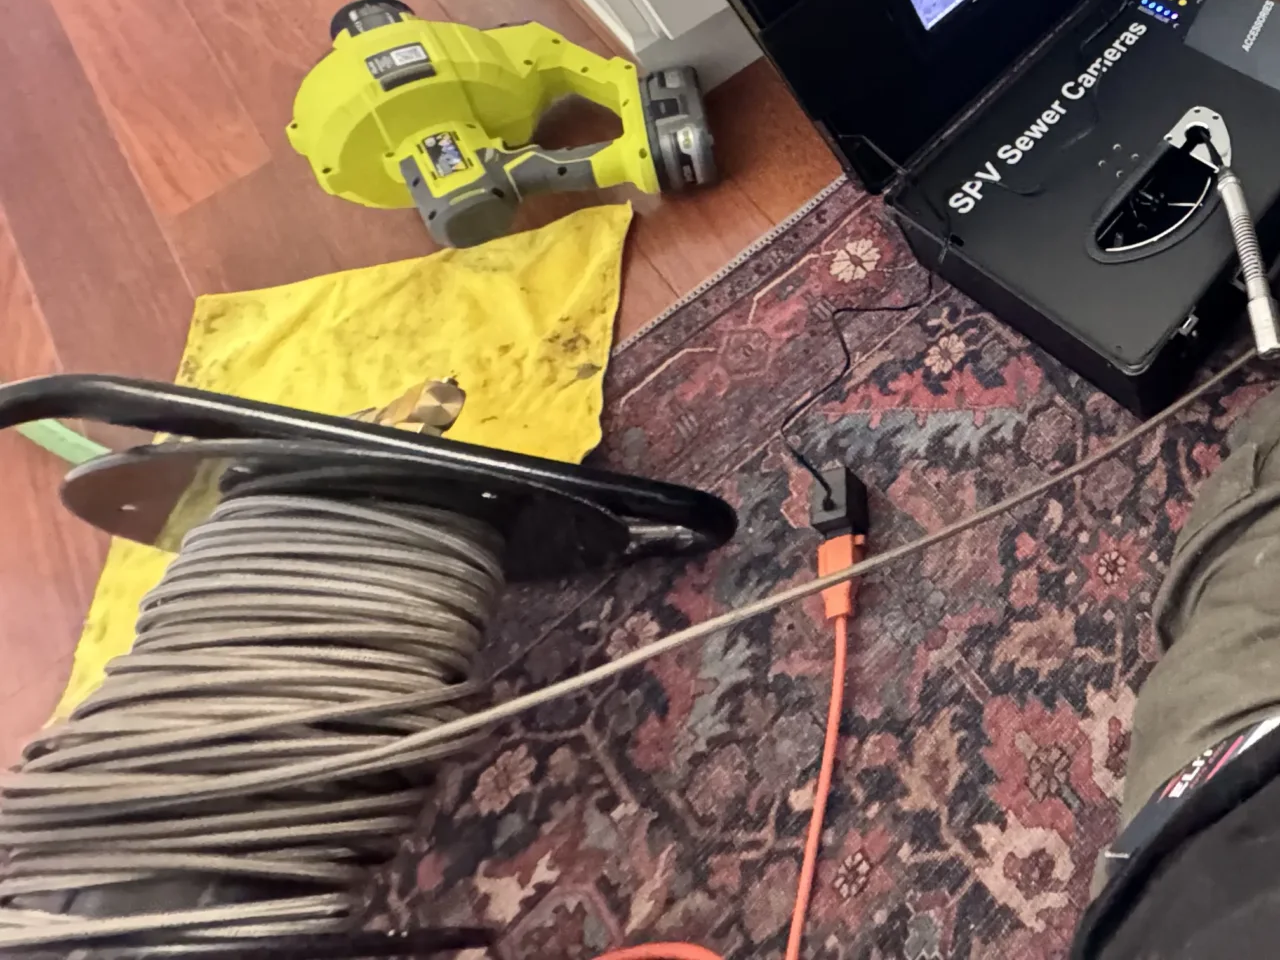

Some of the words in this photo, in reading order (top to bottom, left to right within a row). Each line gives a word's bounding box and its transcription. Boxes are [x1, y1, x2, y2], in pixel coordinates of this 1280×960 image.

[1242, 0, 1274, 52] ACCESSORIES
[948, 161, 1002, 214] SPV
[997, 99, 1067, 165] Sewer
[1061, 22, 1148, 100] Cameras
